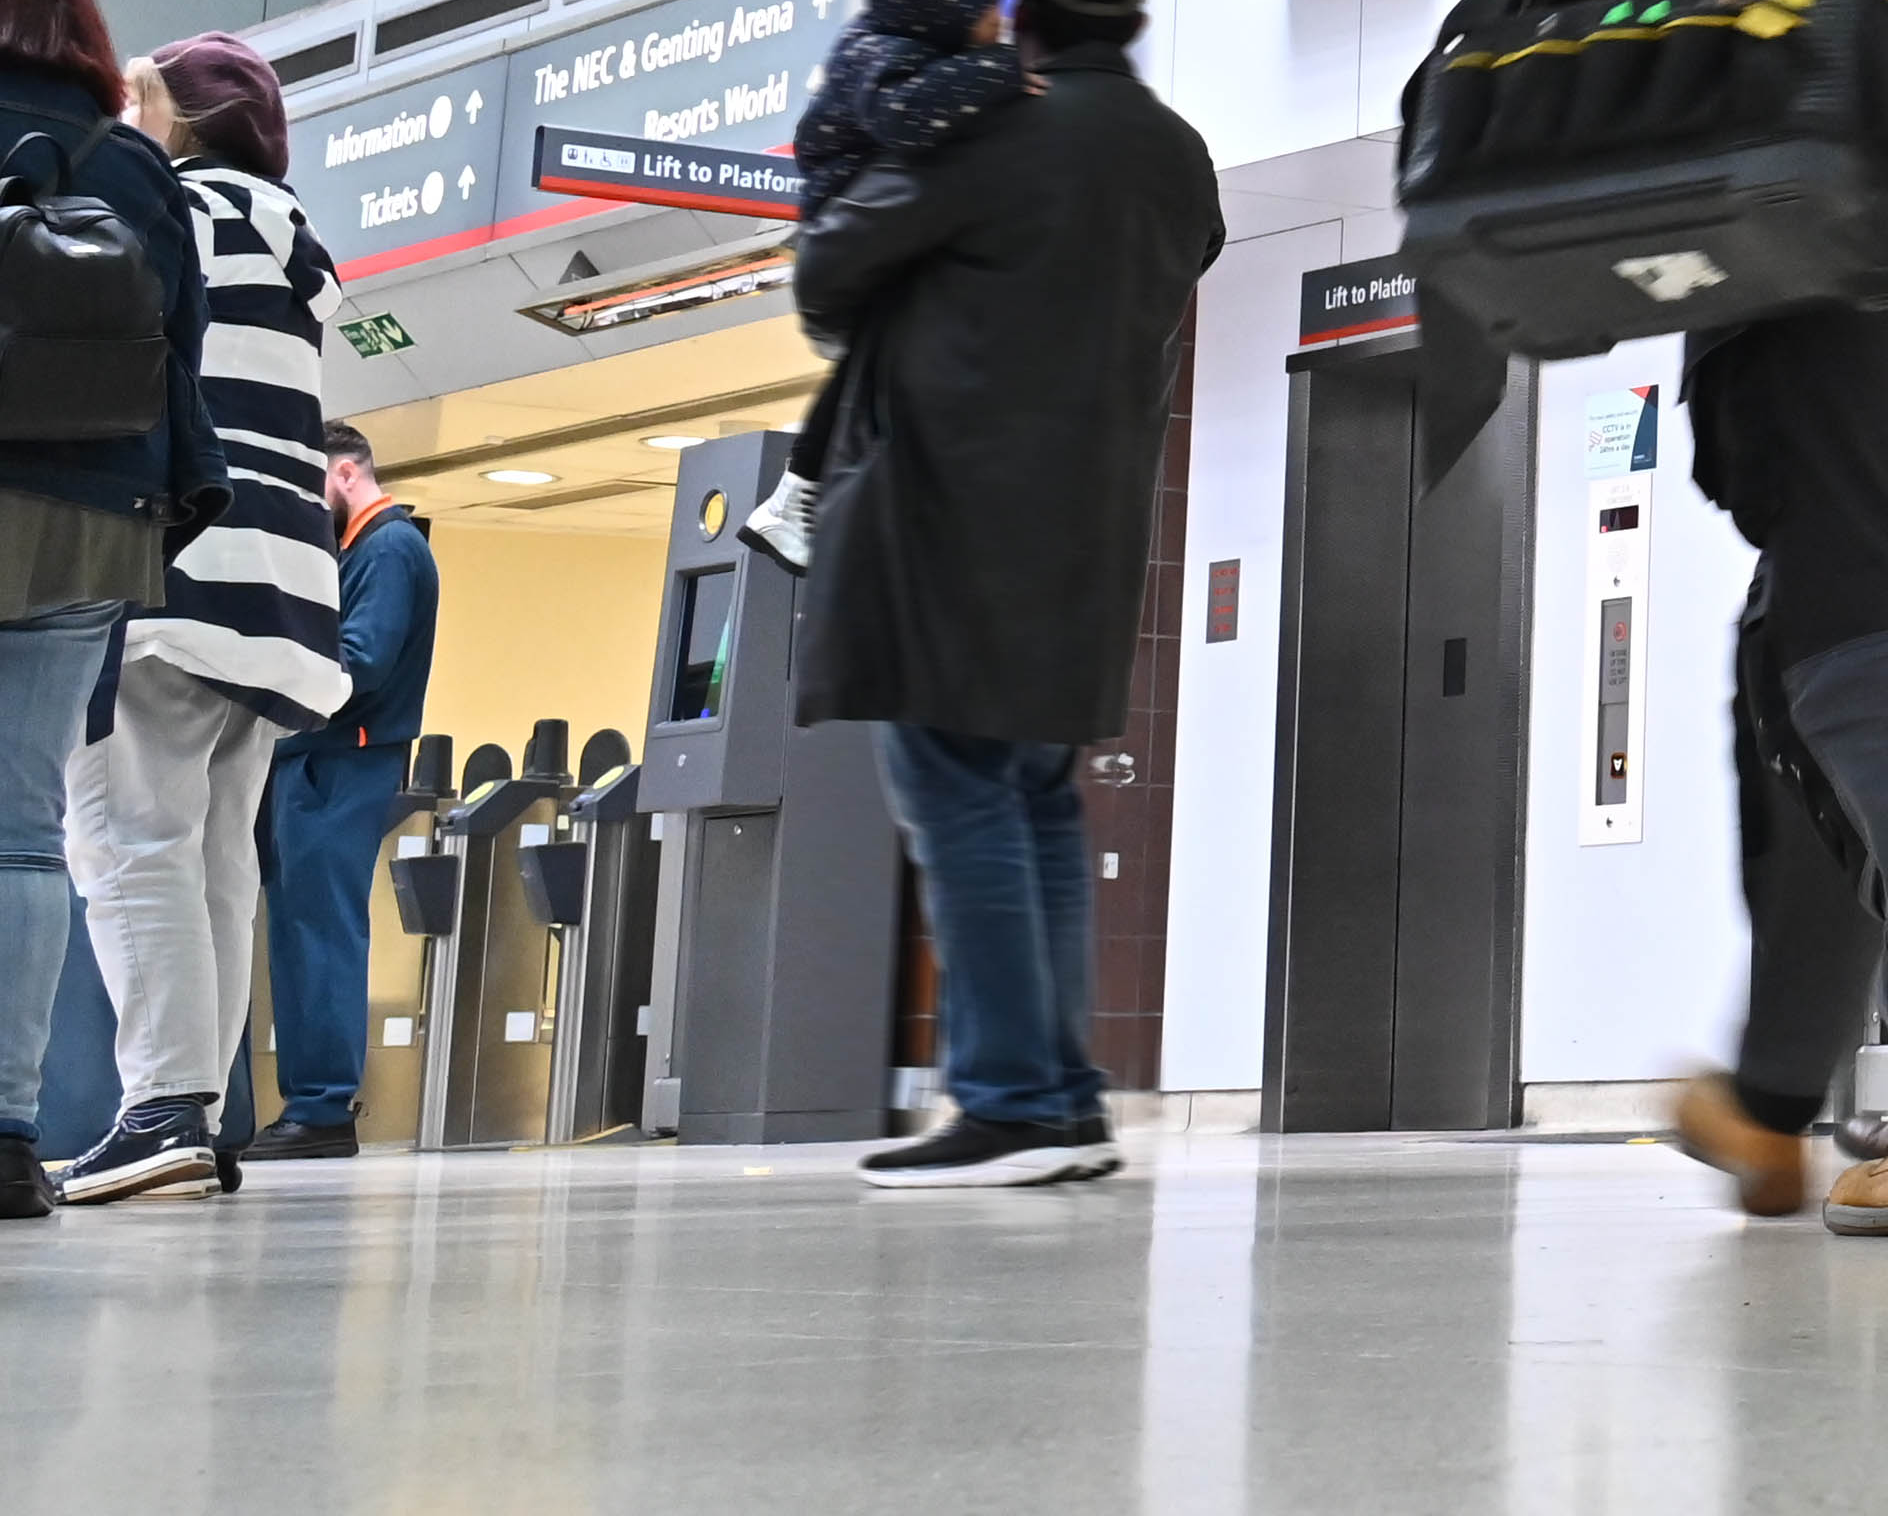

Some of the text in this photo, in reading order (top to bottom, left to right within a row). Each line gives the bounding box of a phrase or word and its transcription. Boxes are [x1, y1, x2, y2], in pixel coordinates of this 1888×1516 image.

[534, 0, 795, 106] The NEC & Genting Arena
[643, 70, 789, 142] Resorts World
[325, 110, 428, 169] Information
[643, 153, 682, 180] Lift
[688, 165, 713, 184] to
[360, 186, 419, 229] Tickets
[1325, 273, 1417, 310] Lift to Platfor
